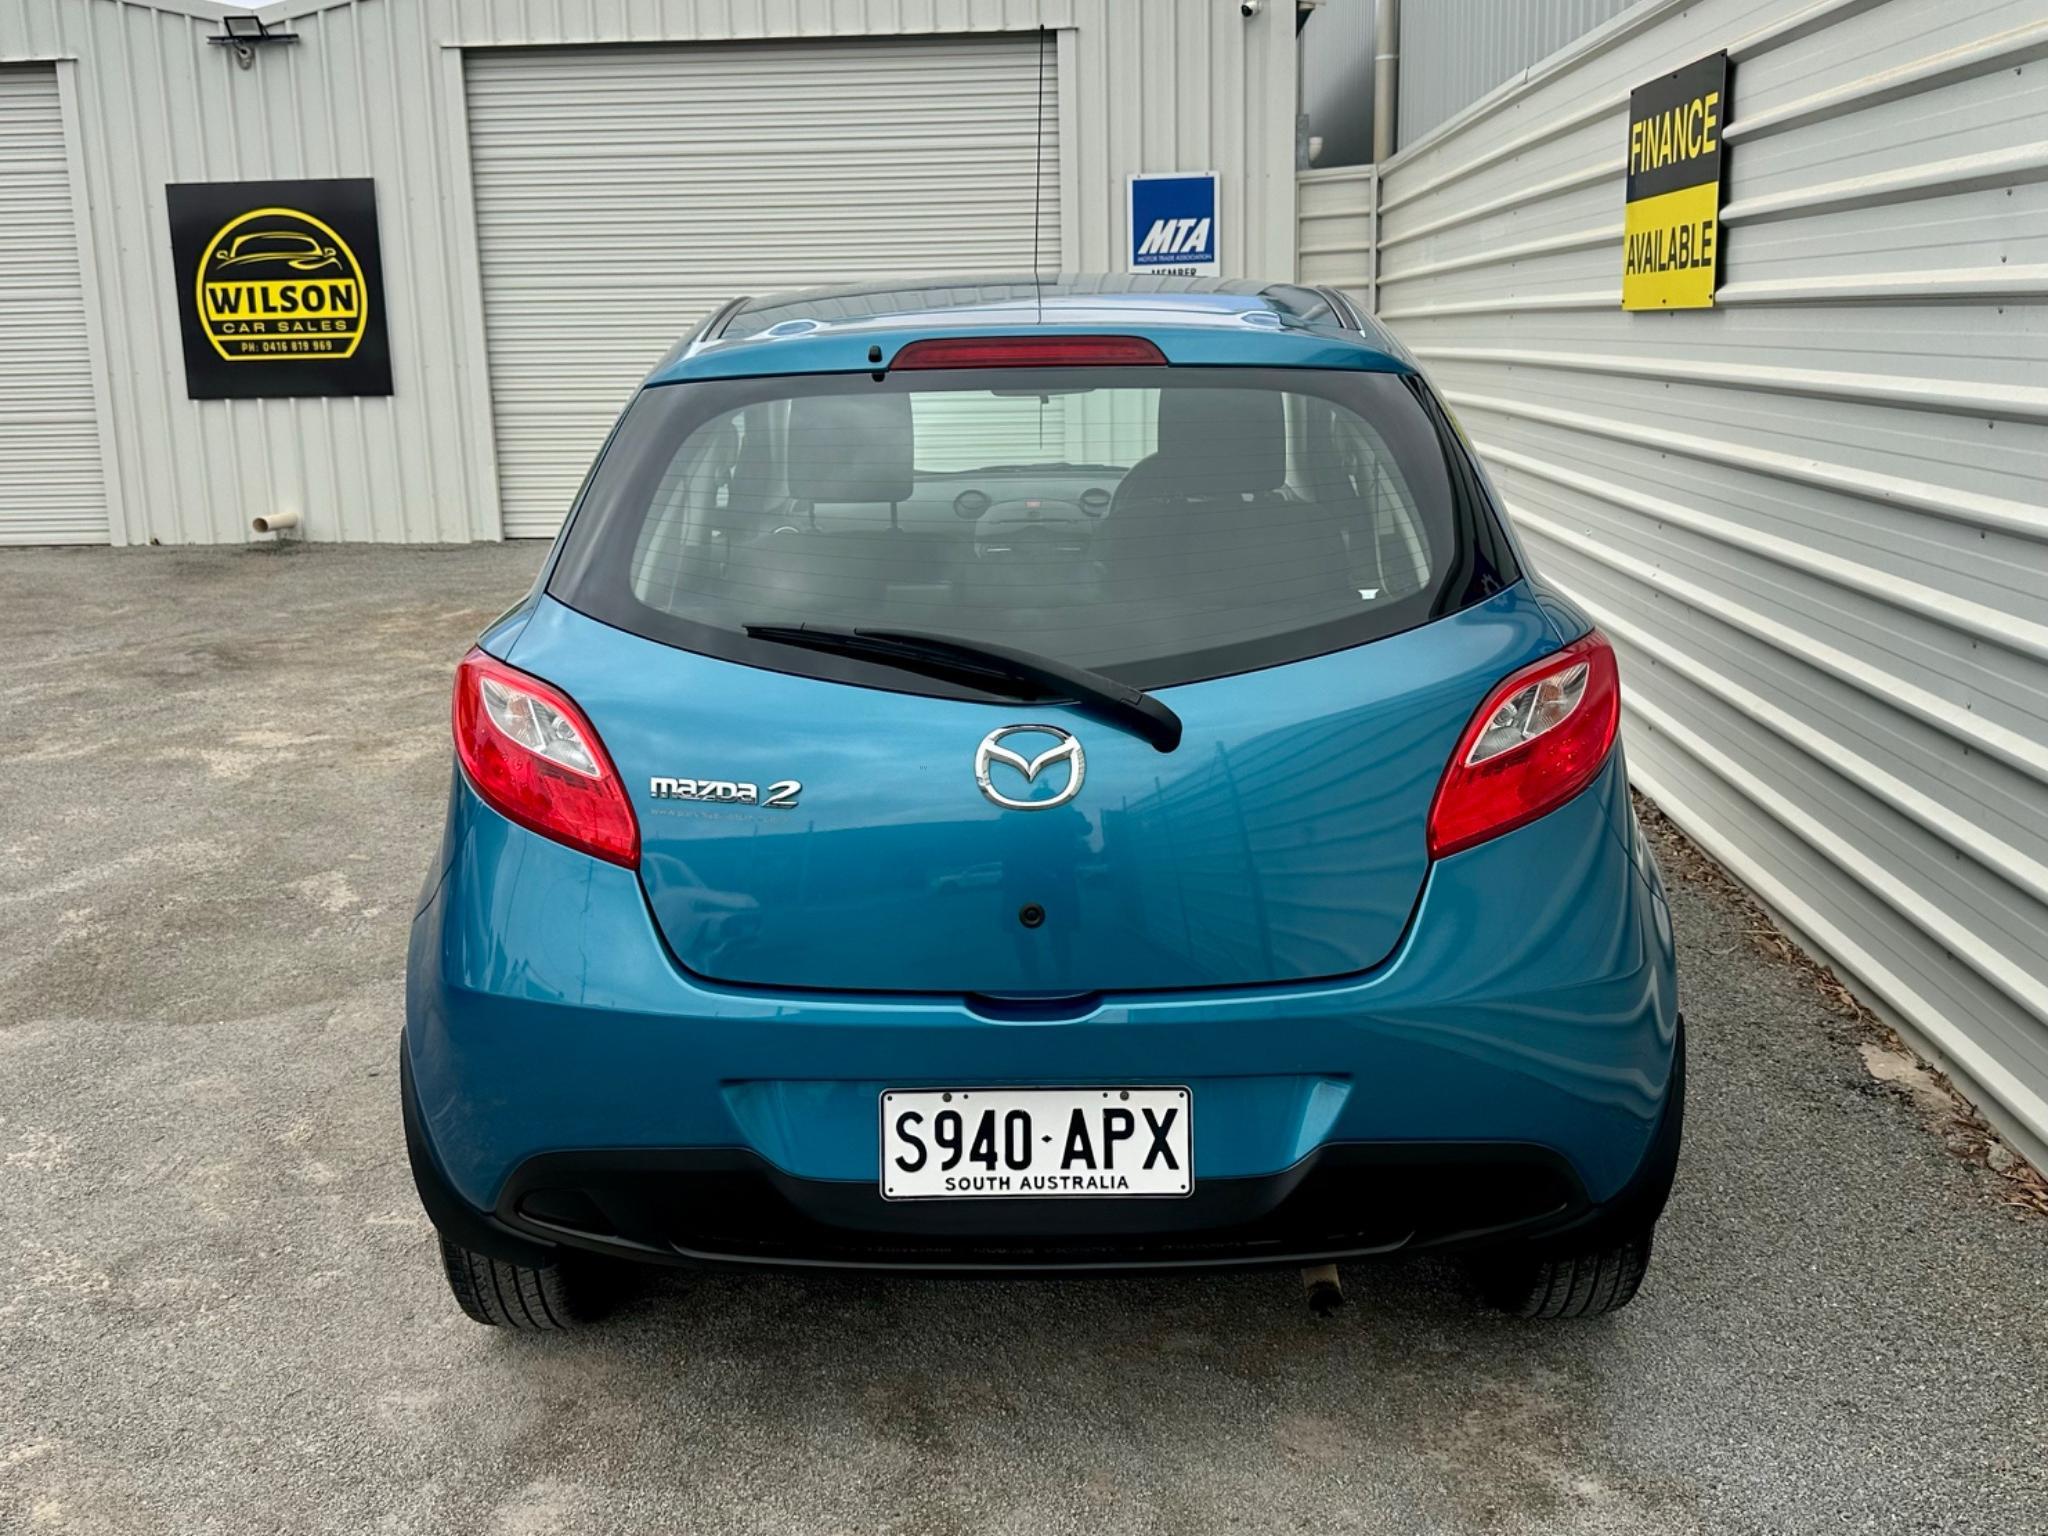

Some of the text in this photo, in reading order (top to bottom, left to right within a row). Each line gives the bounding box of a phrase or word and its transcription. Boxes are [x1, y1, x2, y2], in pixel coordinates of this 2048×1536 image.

[1631, 92, 1718, 176] FINANCE
[1137, 217, 1211, 255] MTA
[1626, 220, 1712, 275] AVAILABLE
[208, 285, 354, 314] WILSON
[222, 320, 347, 334] CAR SALES
[262, 341, 288, 352] 0416
[650, 776, 802, 808] mazda 2
[944, 1175, 1129, 1191] SOUTH AUSTRALIA
